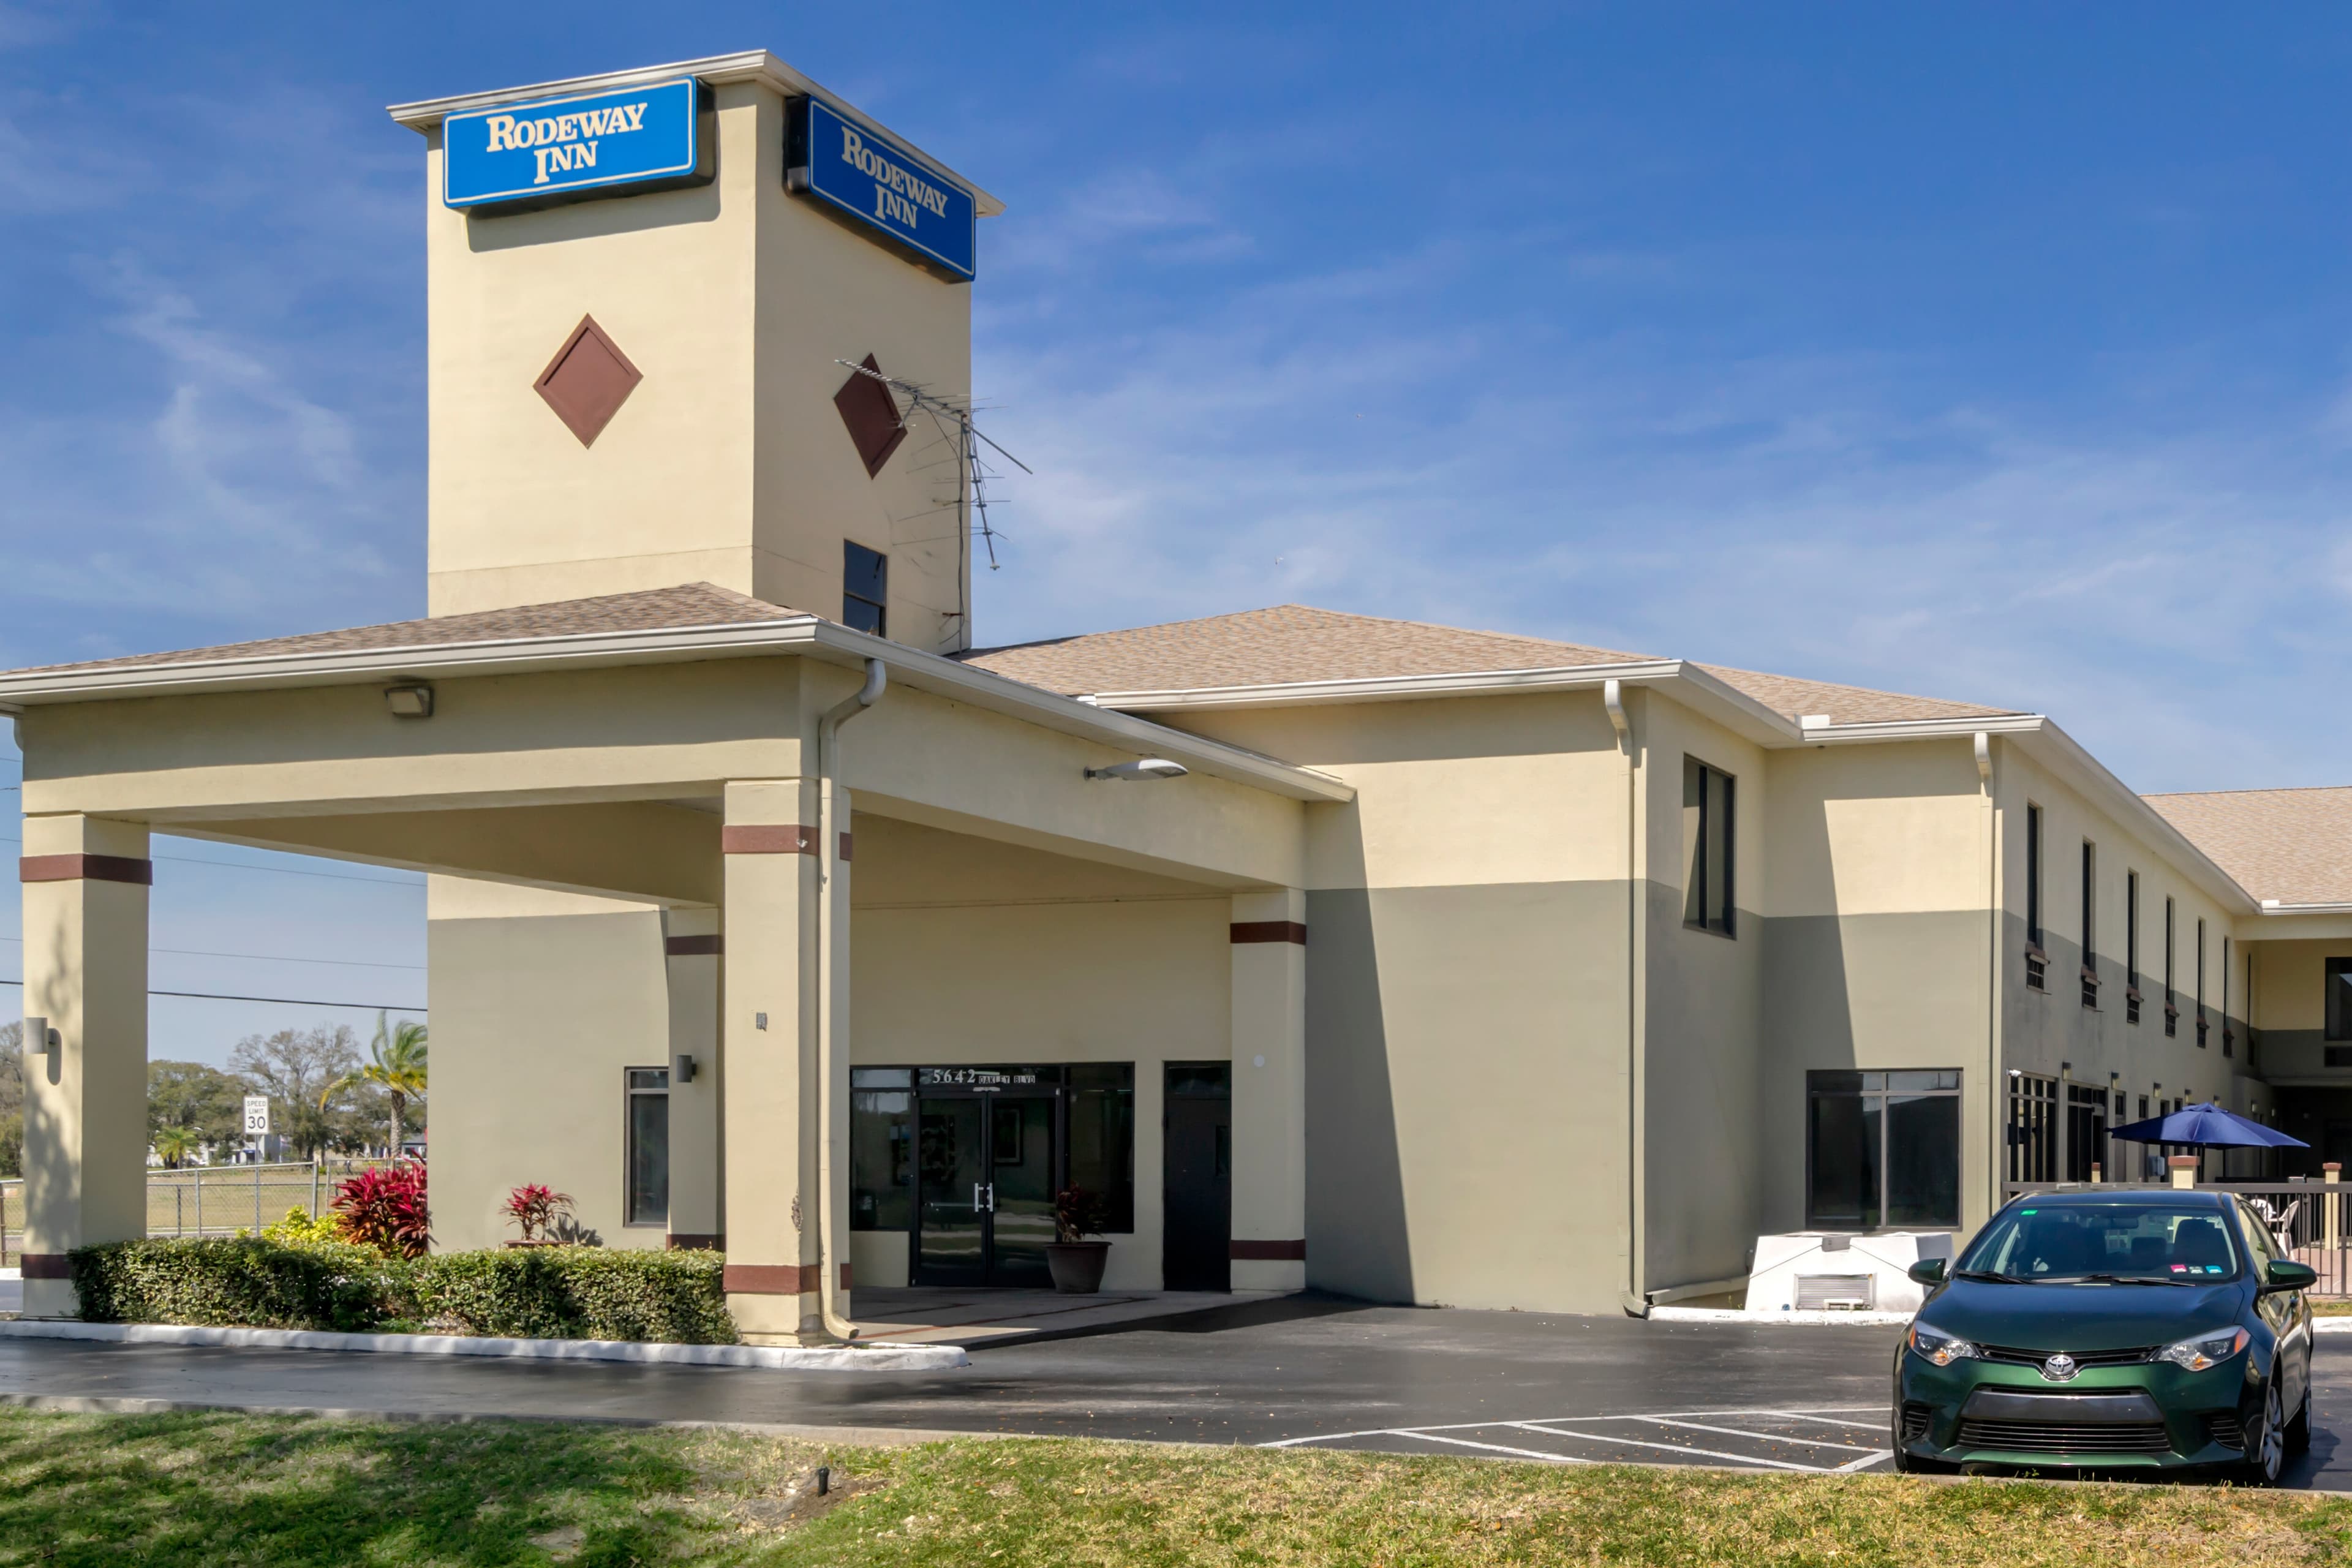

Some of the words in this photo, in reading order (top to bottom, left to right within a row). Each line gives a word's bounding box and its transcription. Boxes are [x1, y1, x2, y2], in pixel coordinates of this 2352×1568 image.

[486, 102, 647, 153] RODEWAY
[533, 141, 598, 184] INN
[841, 126, 948, 219] RODEWAY
[875, 183, 918, 229] INN
[932, 1069, 976, 1084] 5642
[248, 1116, 265, 1129] 30
